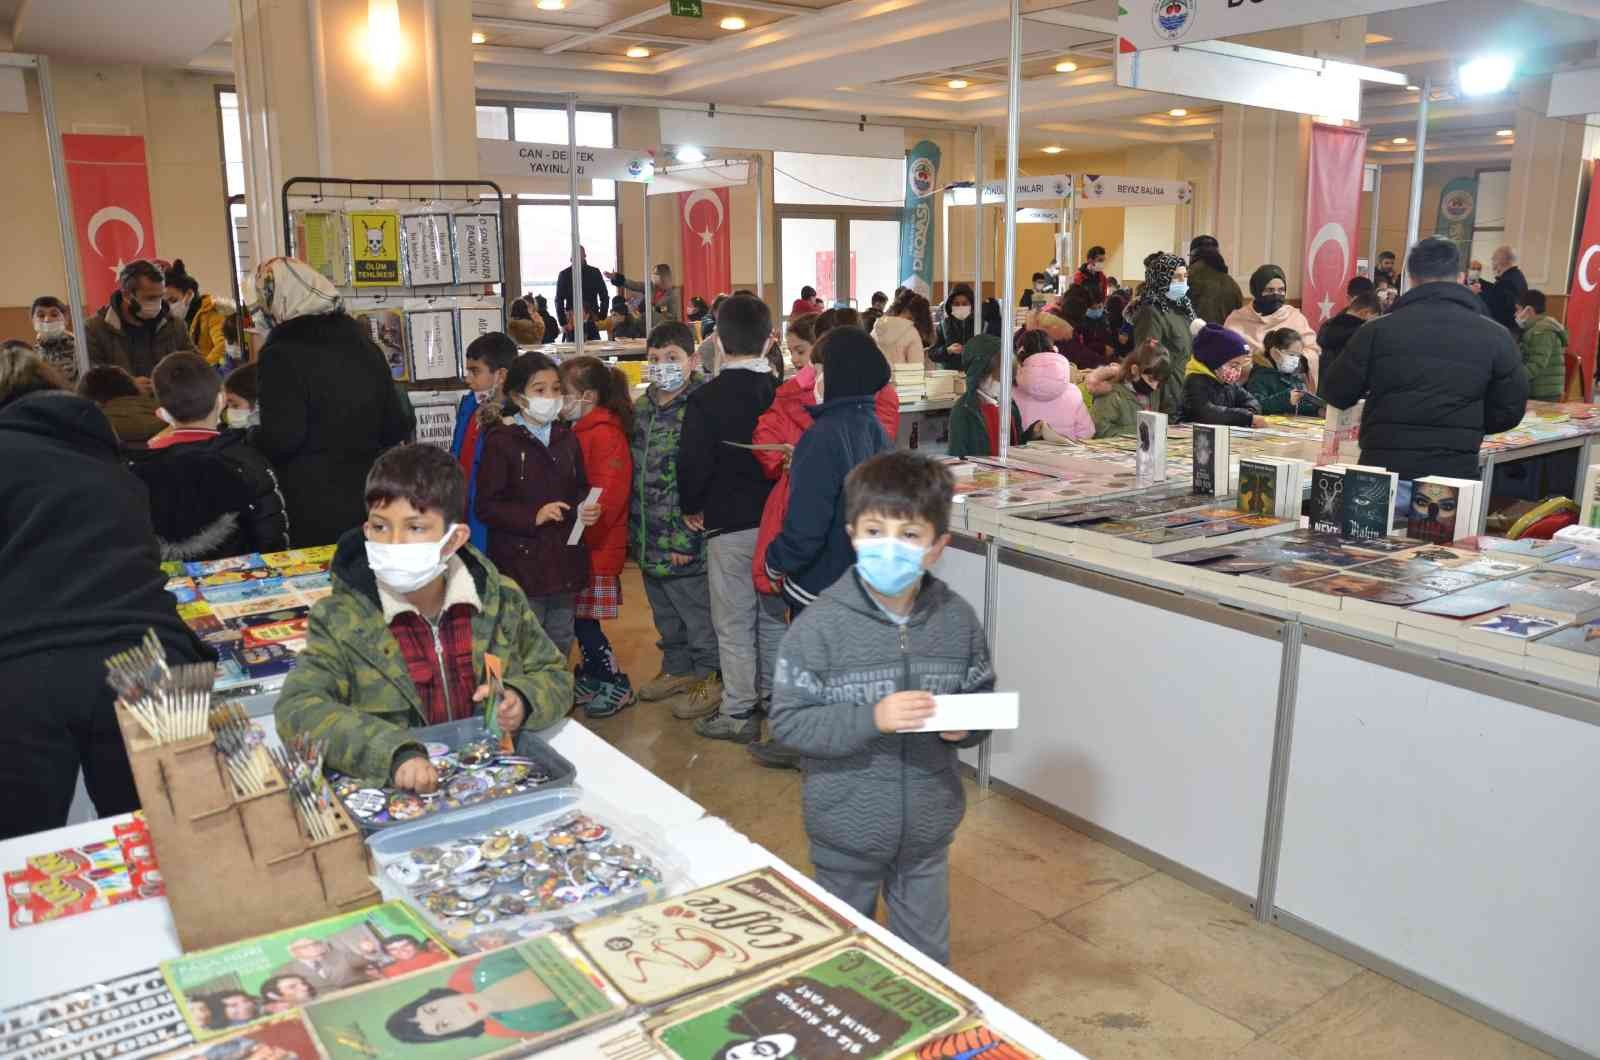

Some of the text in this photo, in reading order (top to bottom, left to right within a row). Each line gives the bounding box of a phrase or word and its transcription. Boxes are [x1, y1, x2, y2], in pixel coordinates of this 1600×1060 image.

[519, 148, 543, 159] CAN
[552, 151, 595, 162] DETEK
[1117, 184, 1140, 194] BEYAZ
[684, 897, 804, 949] Coffee
